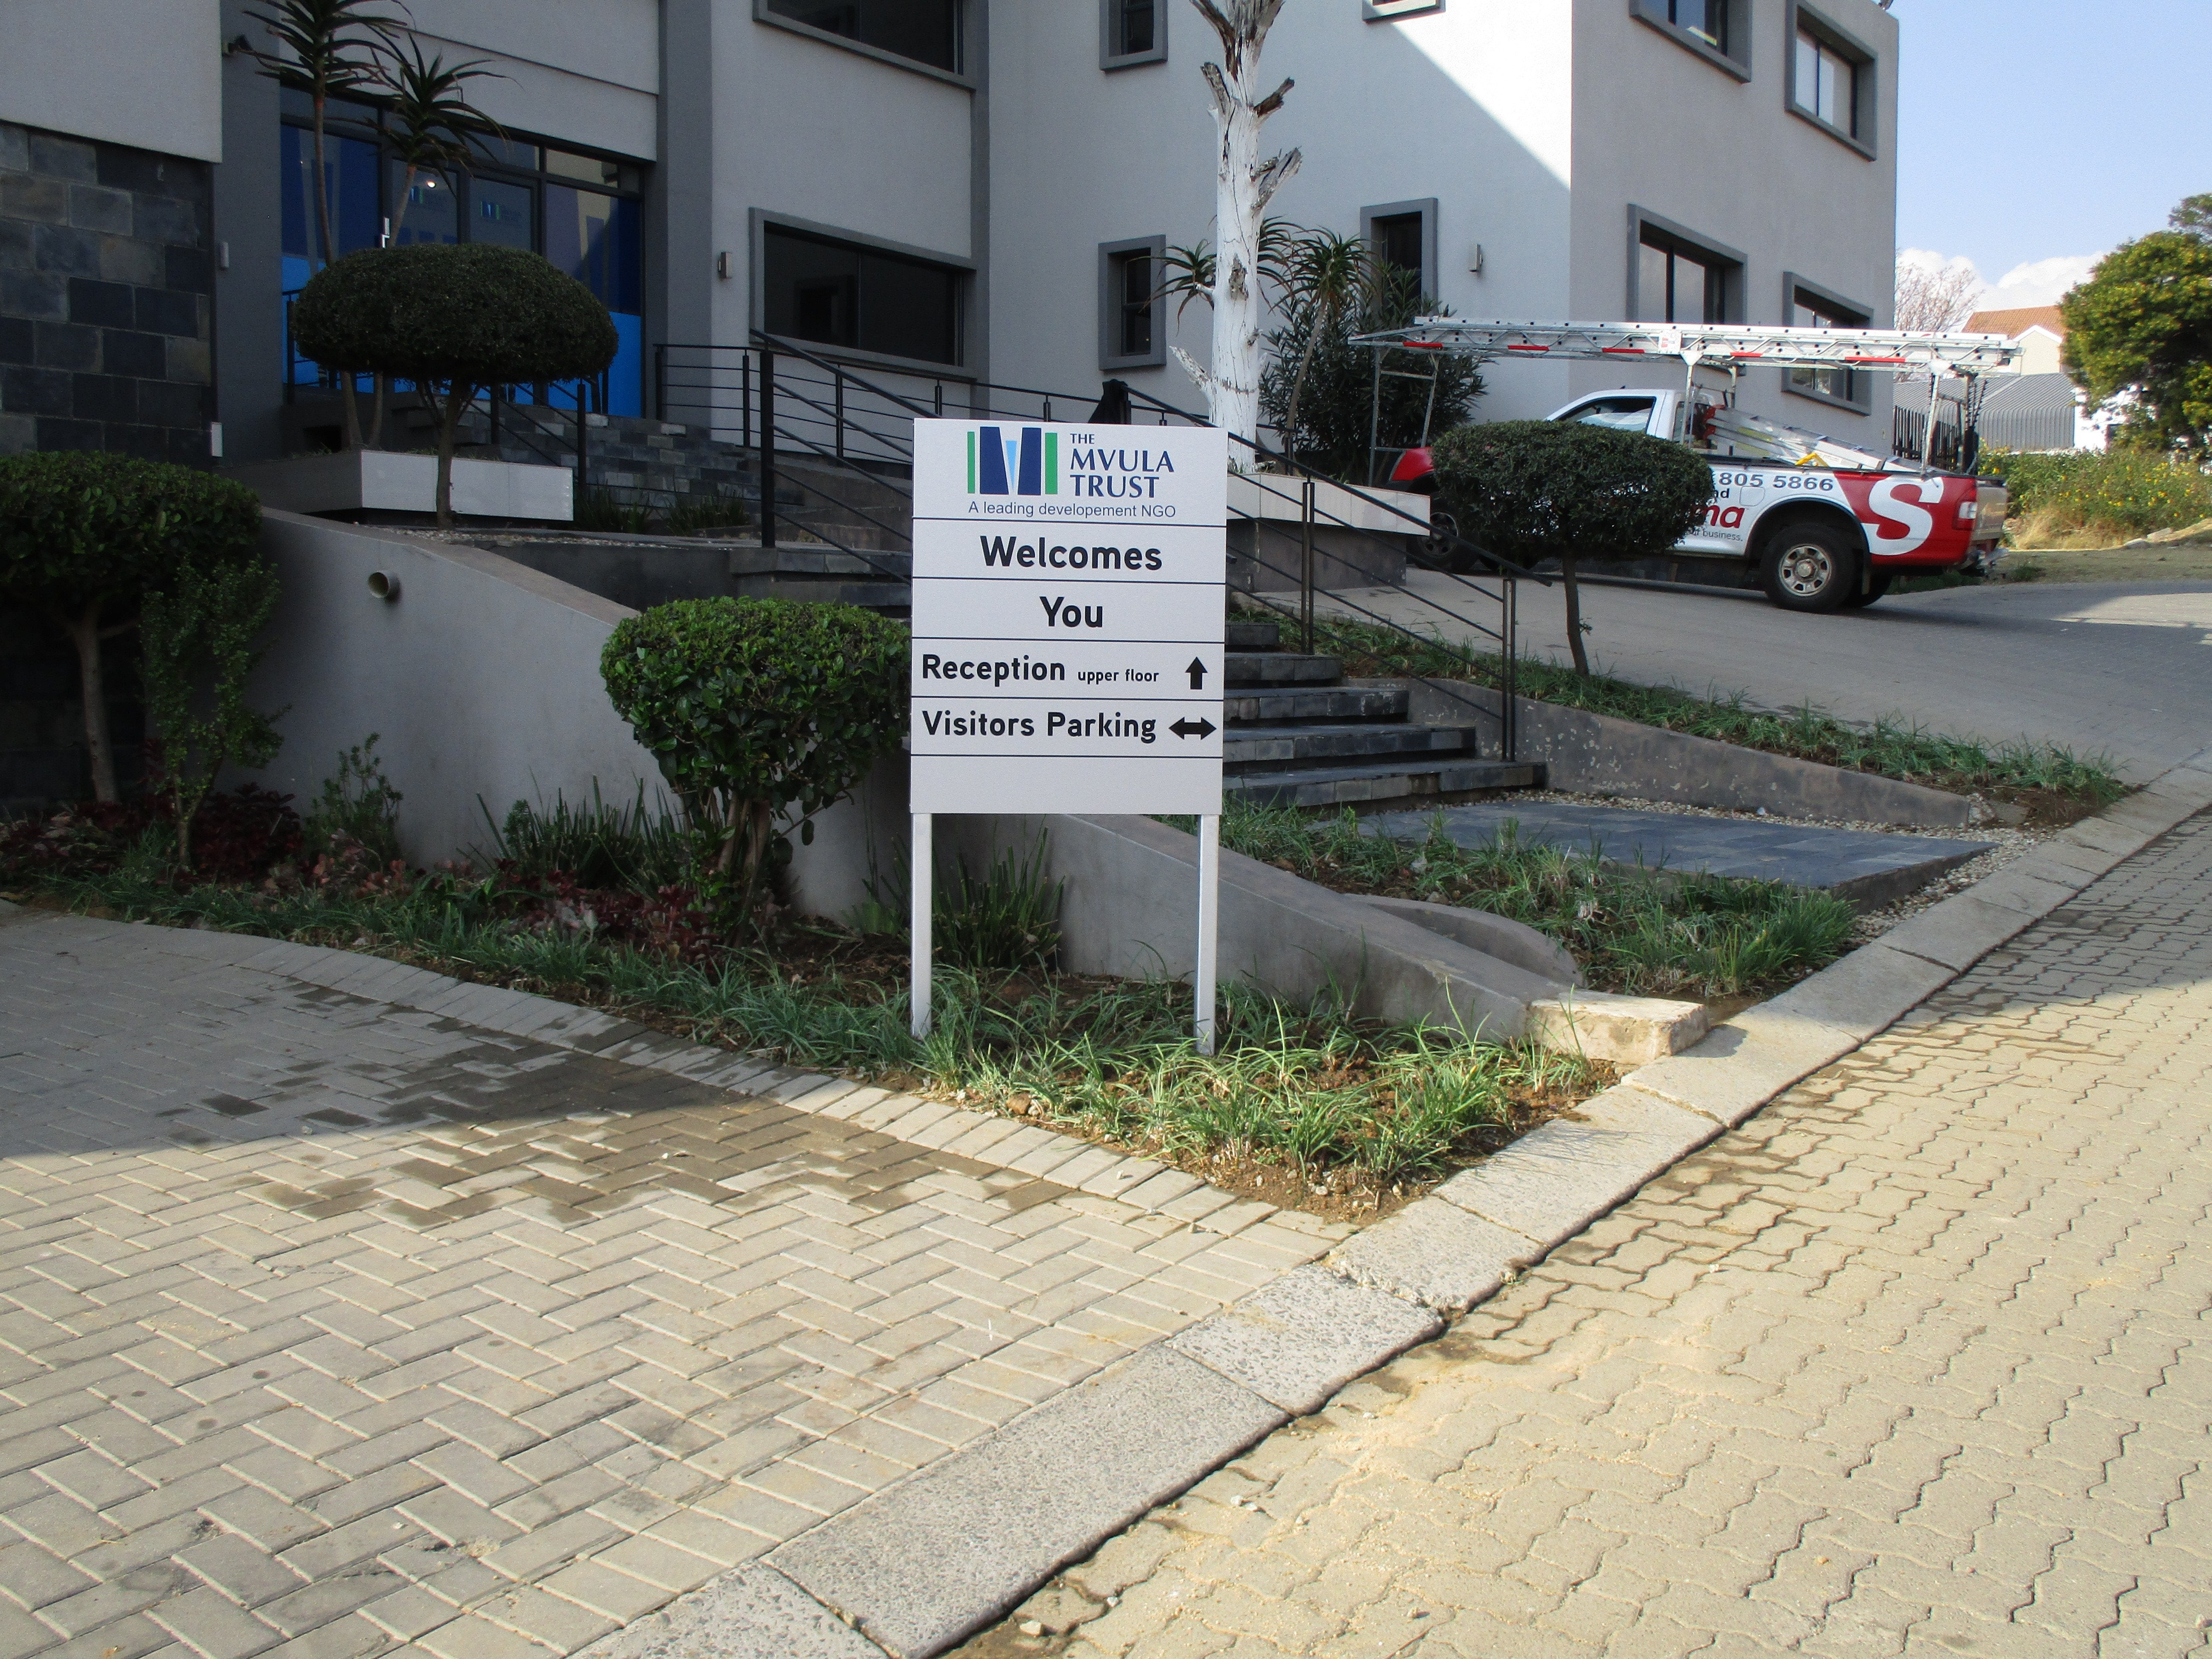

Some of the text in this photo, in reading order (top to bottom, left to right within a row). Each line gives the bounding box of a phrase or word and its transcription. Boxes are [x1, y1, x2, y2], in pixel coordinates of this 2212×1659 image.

[1070, 433, 1095, 444] THE
[1070, 448, 1175, 473] MVULA
[1070, 474, 1160, 498] TRUST
[1719, 472, 1834, 492] 805 5866
[968, 501, 1176, 519] A leading developement NGO
[979, 535, 1163, 571] Welcomes
[1039, 596, 1103, 628] You
[922, 654, 1160, 687] Reception upper floor
[922, 710, 1157, 744] Visitors Parking
